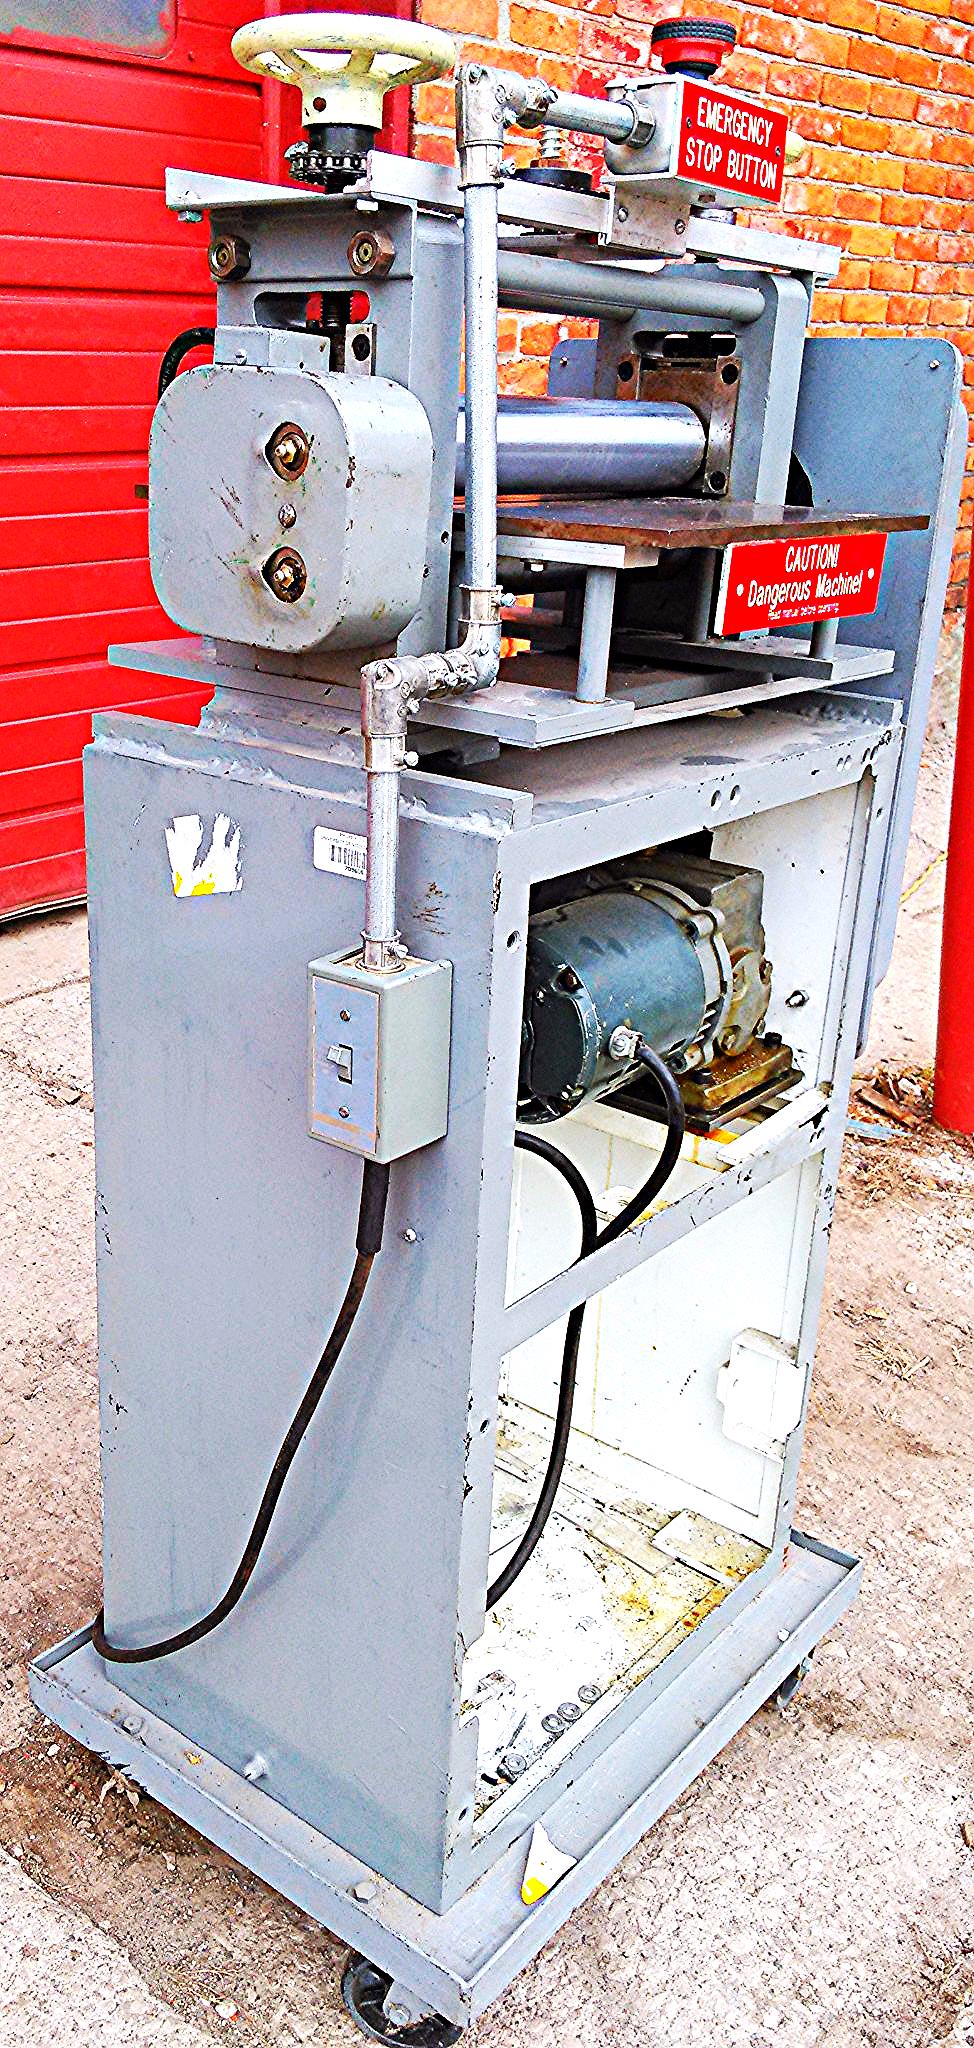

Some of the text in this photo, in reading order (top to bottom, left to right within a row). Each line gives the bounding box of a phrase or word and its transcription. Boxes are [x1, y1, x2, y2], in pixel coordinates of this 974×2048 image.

[697, 97, 773, 147] EMERGENCY
[685, 137, 778, 190] STOP BUTTON
[785, 543, 840, 573] CAUTION!
[747, 570, 864, 610] Dangerous Machine!
